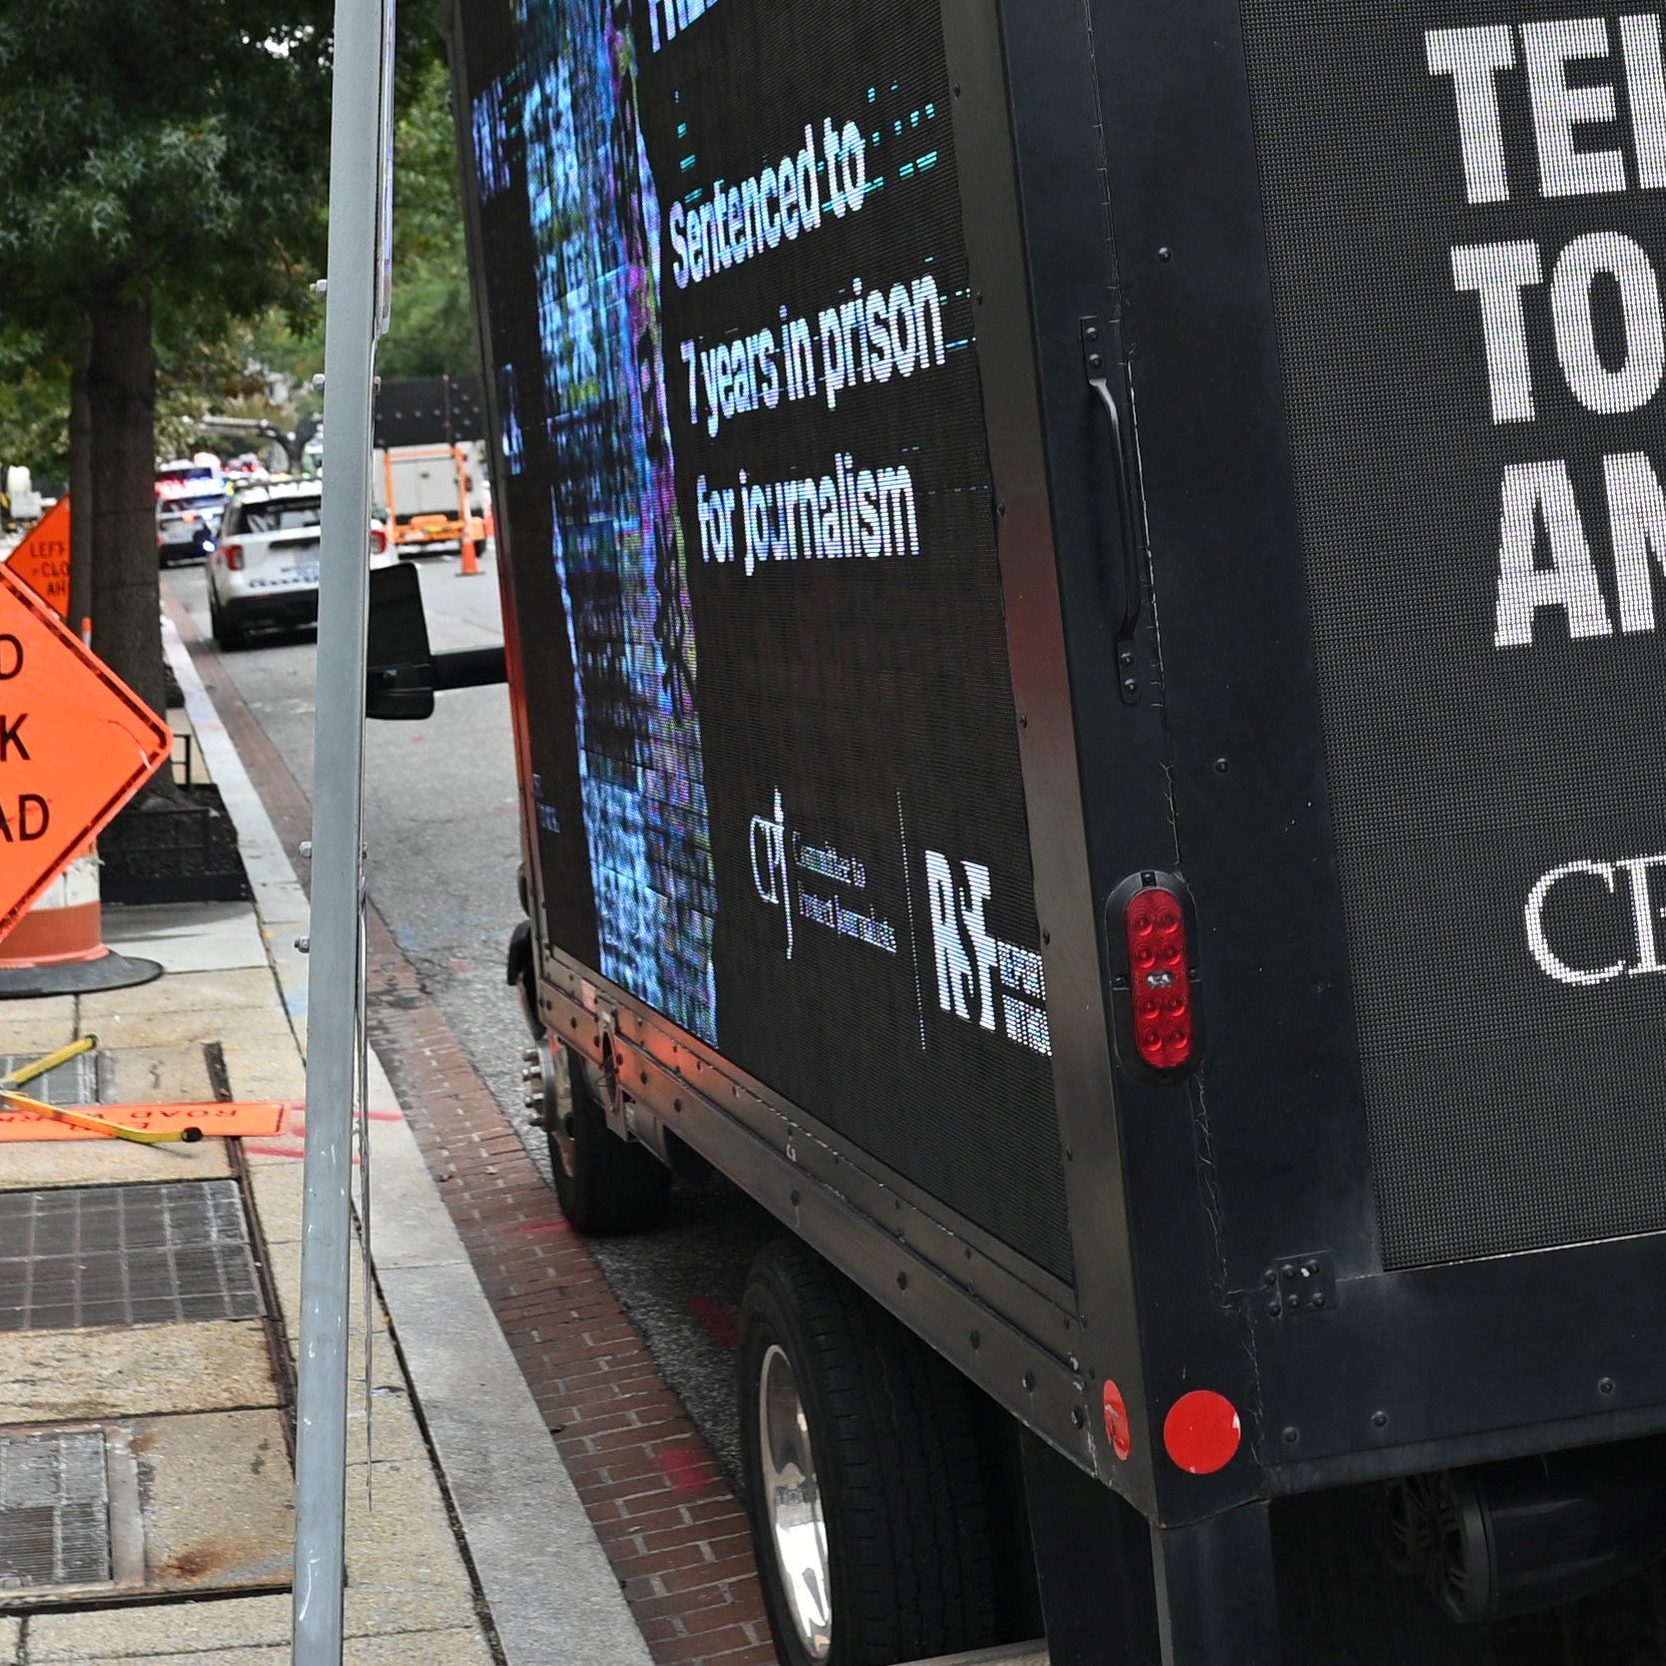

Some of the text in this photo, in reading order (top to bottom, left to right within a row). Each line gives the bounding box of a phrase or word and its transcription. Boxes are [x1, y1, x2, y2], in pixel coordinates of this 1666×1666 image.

[668, 122, 822, 290] Sentenced
[821, 116, 868, 219] to
[680, 274, 946, 438] 7 years in prison
[1449, 230, 1666, 426] TO
[695, 452, 920, 577] for journalism
